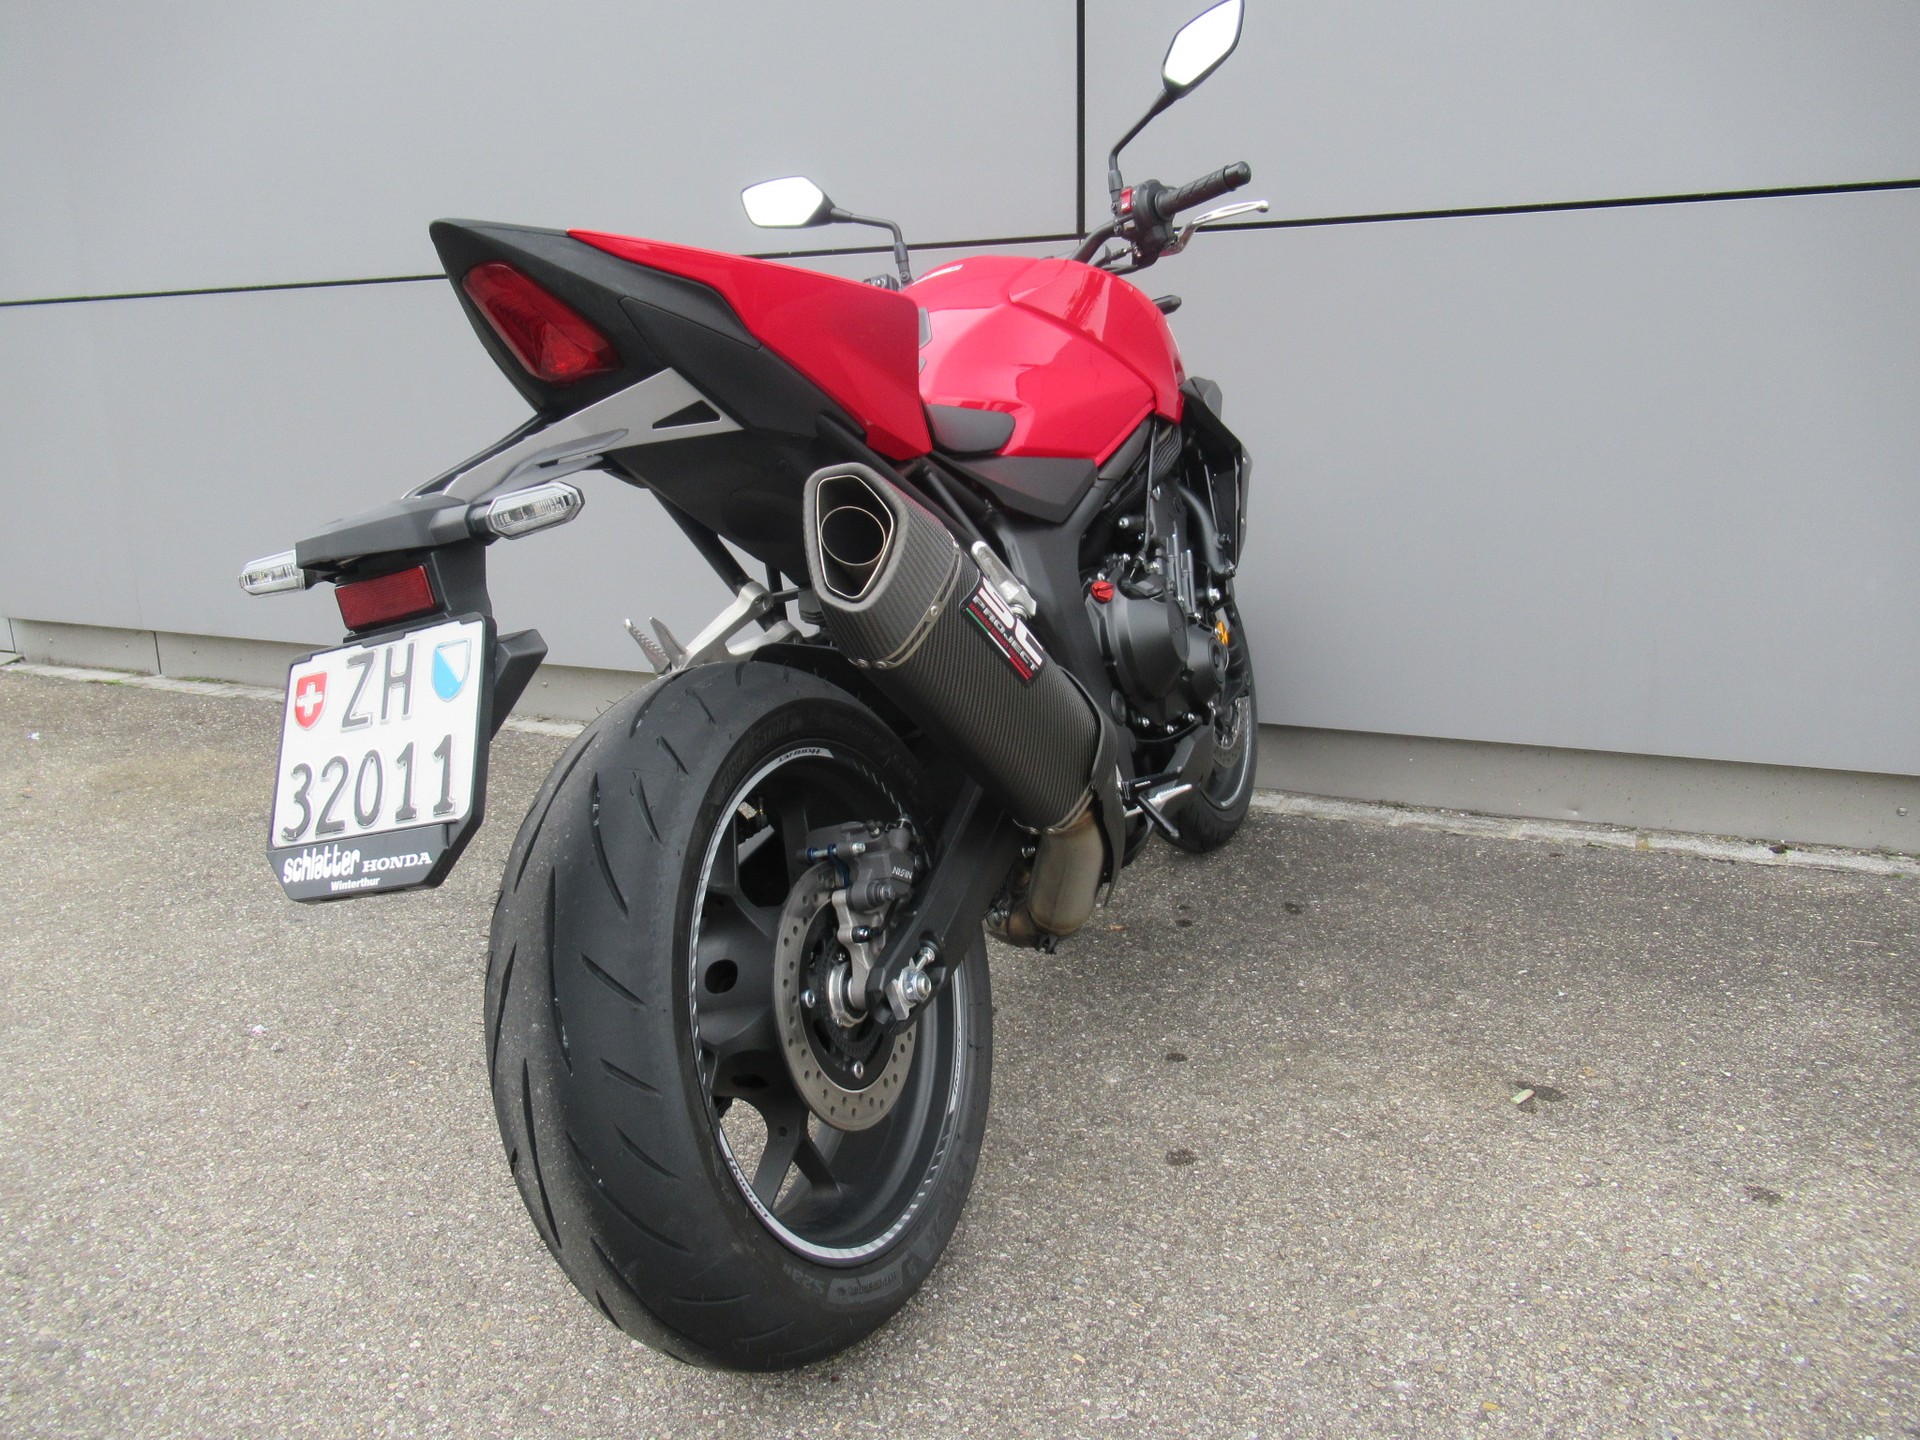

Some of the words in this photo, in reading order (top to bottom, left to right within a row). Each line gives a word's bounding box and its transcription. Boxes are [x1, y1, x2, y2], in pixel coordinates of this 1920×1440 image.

[972, 594, 1039, 672] PROJECT
[341, 641, 418, 731] ZH
[282, 734, 457, 842] 32011
[331, 876, 381, 892] Winterthur
[362, 852, 433, 874] HONDA
